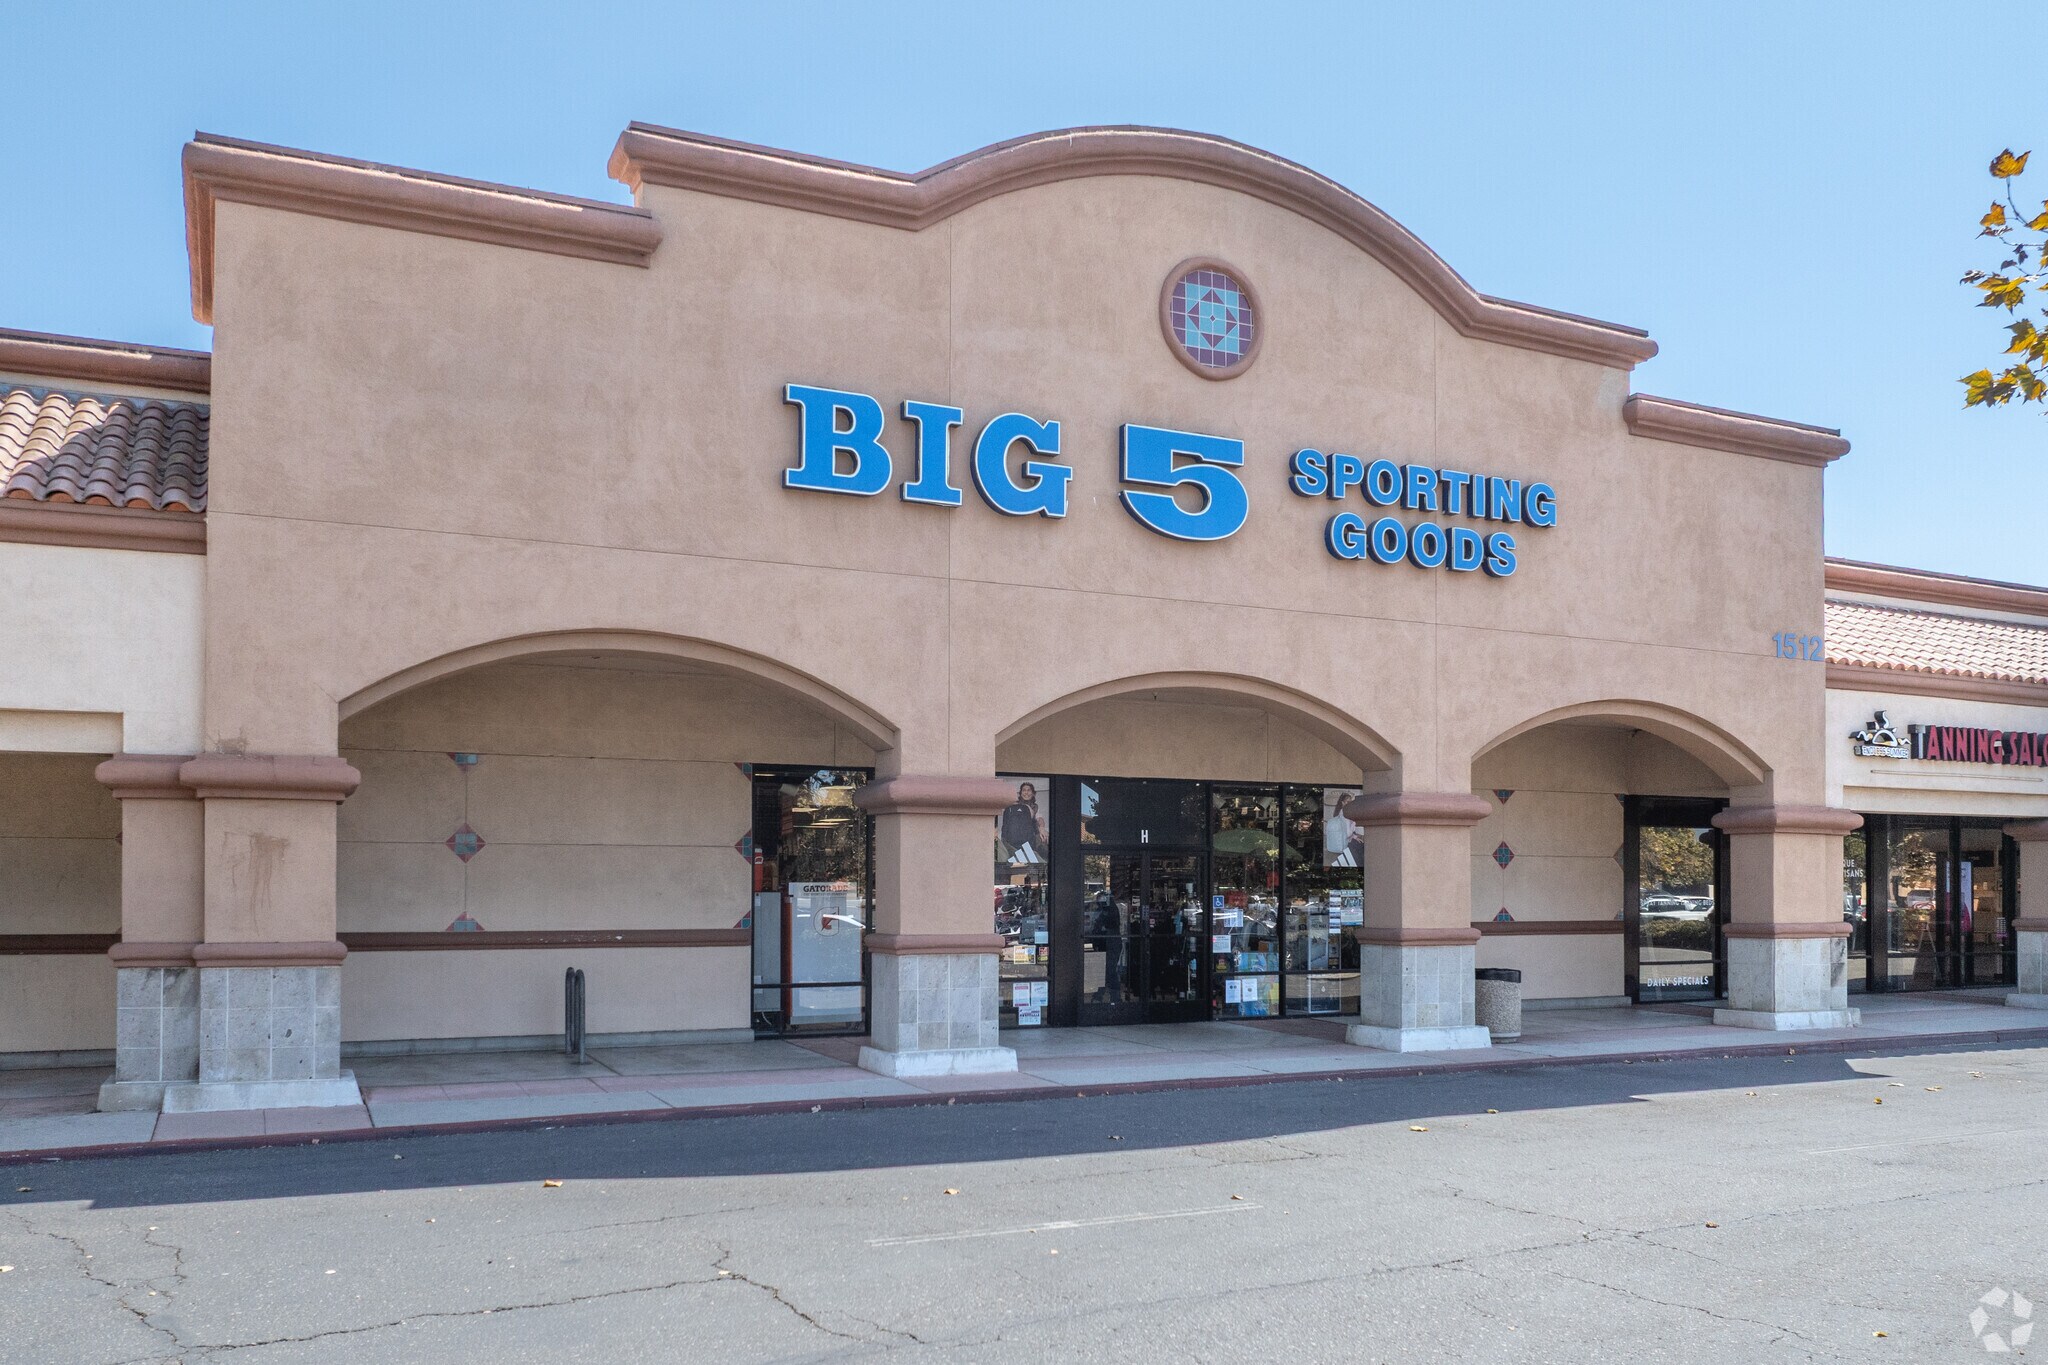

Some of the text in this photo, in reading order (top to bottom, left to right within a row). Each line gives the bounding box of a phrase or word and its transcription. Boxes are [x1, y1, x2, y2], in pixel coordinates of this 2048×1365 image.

[783, 383, 1249, 542] BIG 5
[1289, 448, 1557, 529] SPORTING
[1325, 512, 1518, 578] GOODS
[1772, 631, 1825, 662] 1512
[1908, 724, 2003, 764] TANNING
[1141, 829, 1149, 843] H
[803, 885, 848, 893] GATORADE
[1647, 976, 1709, 987] DAILY SPECIALS
